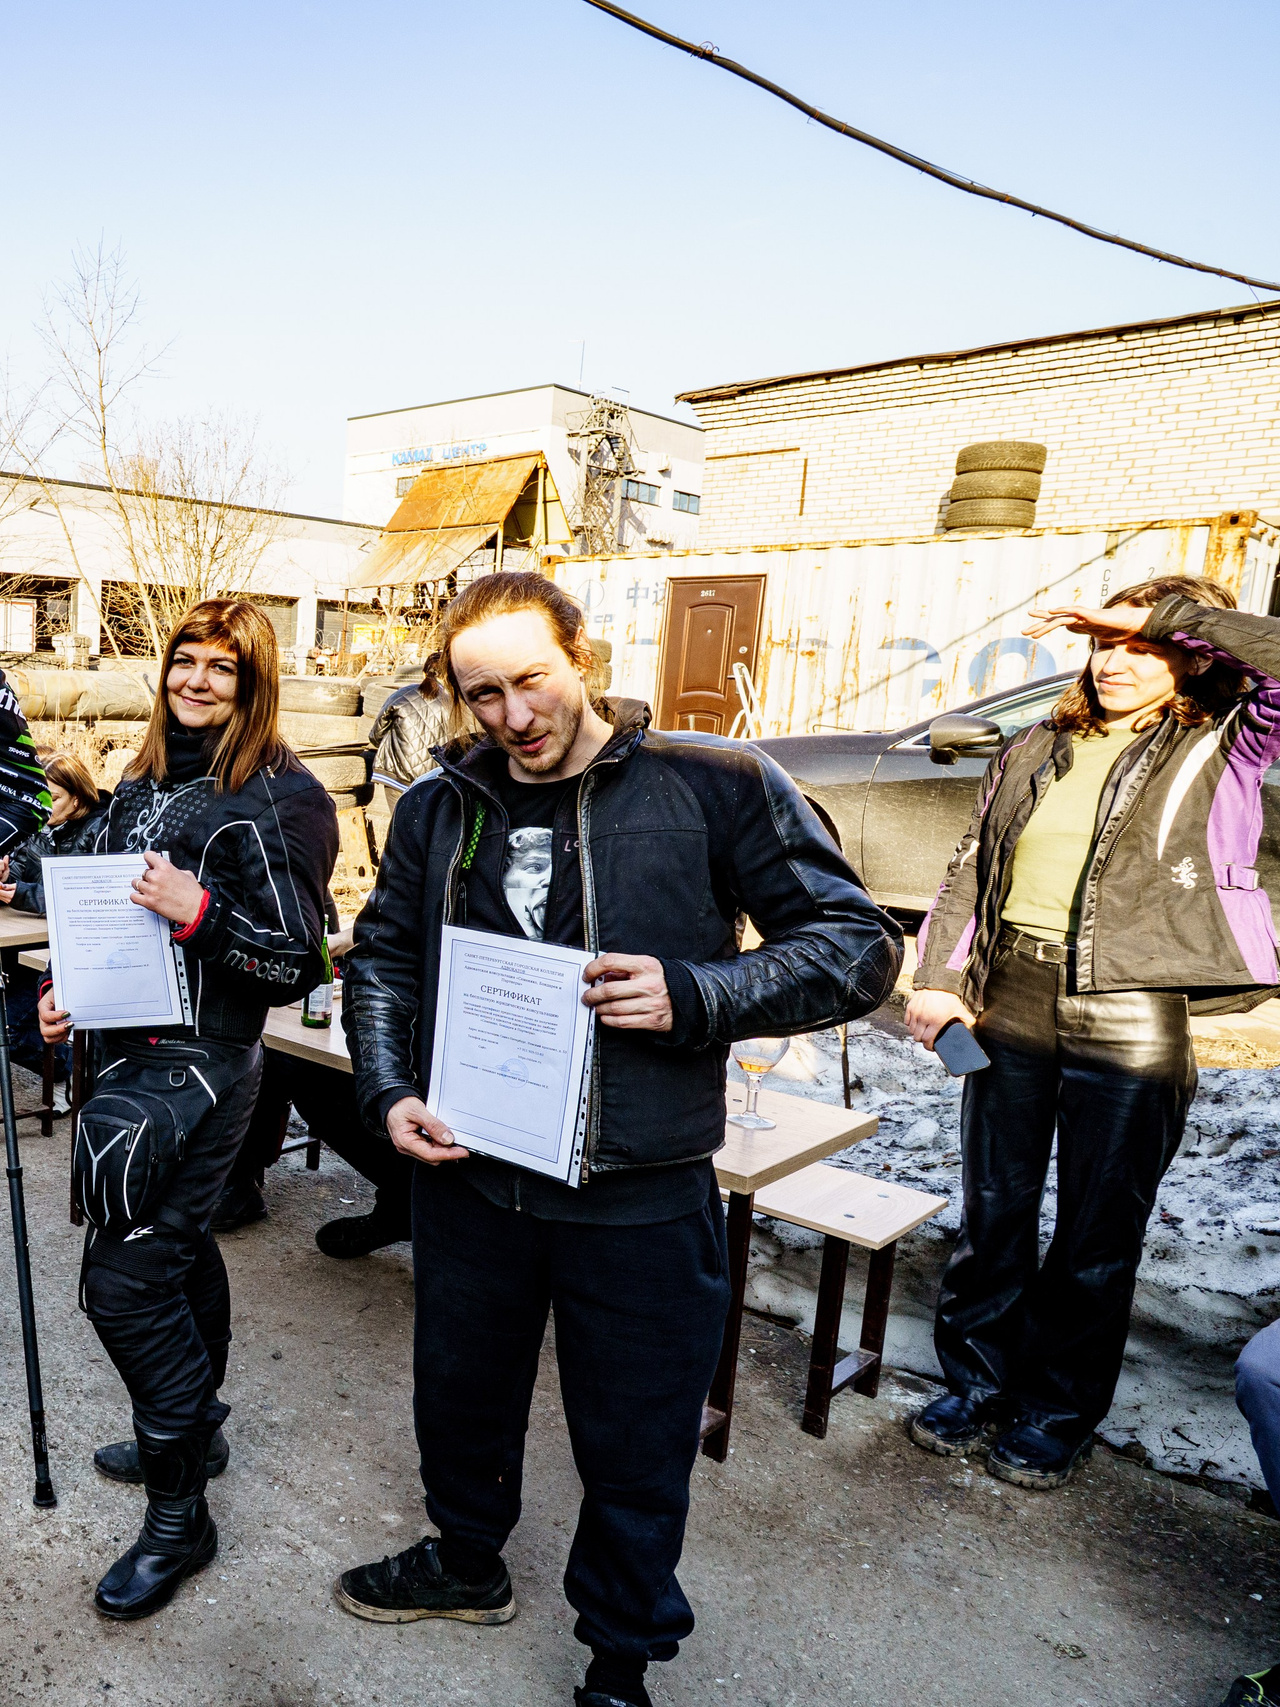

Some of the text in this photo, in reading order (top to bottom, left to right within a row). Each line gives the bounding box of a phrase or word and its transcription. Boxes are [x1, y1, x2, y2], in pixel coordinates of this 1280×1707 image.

[442, 443, 487, 459] ЦЕНТР
[78, 898, 129, 906] СЕРТИФИКАТ
[223, 949, 301, 985] modeka
[463, 951, 564, 977] САНКТ-ПЕТЕРБУРГСКАЯ ГОРОДСКАЯ КОЛЛЕГИЯ
[501, 964, 525, 974] АДВОКАТОВ
[480, 983, 542, 1007] СЕРТИФИКАТ
